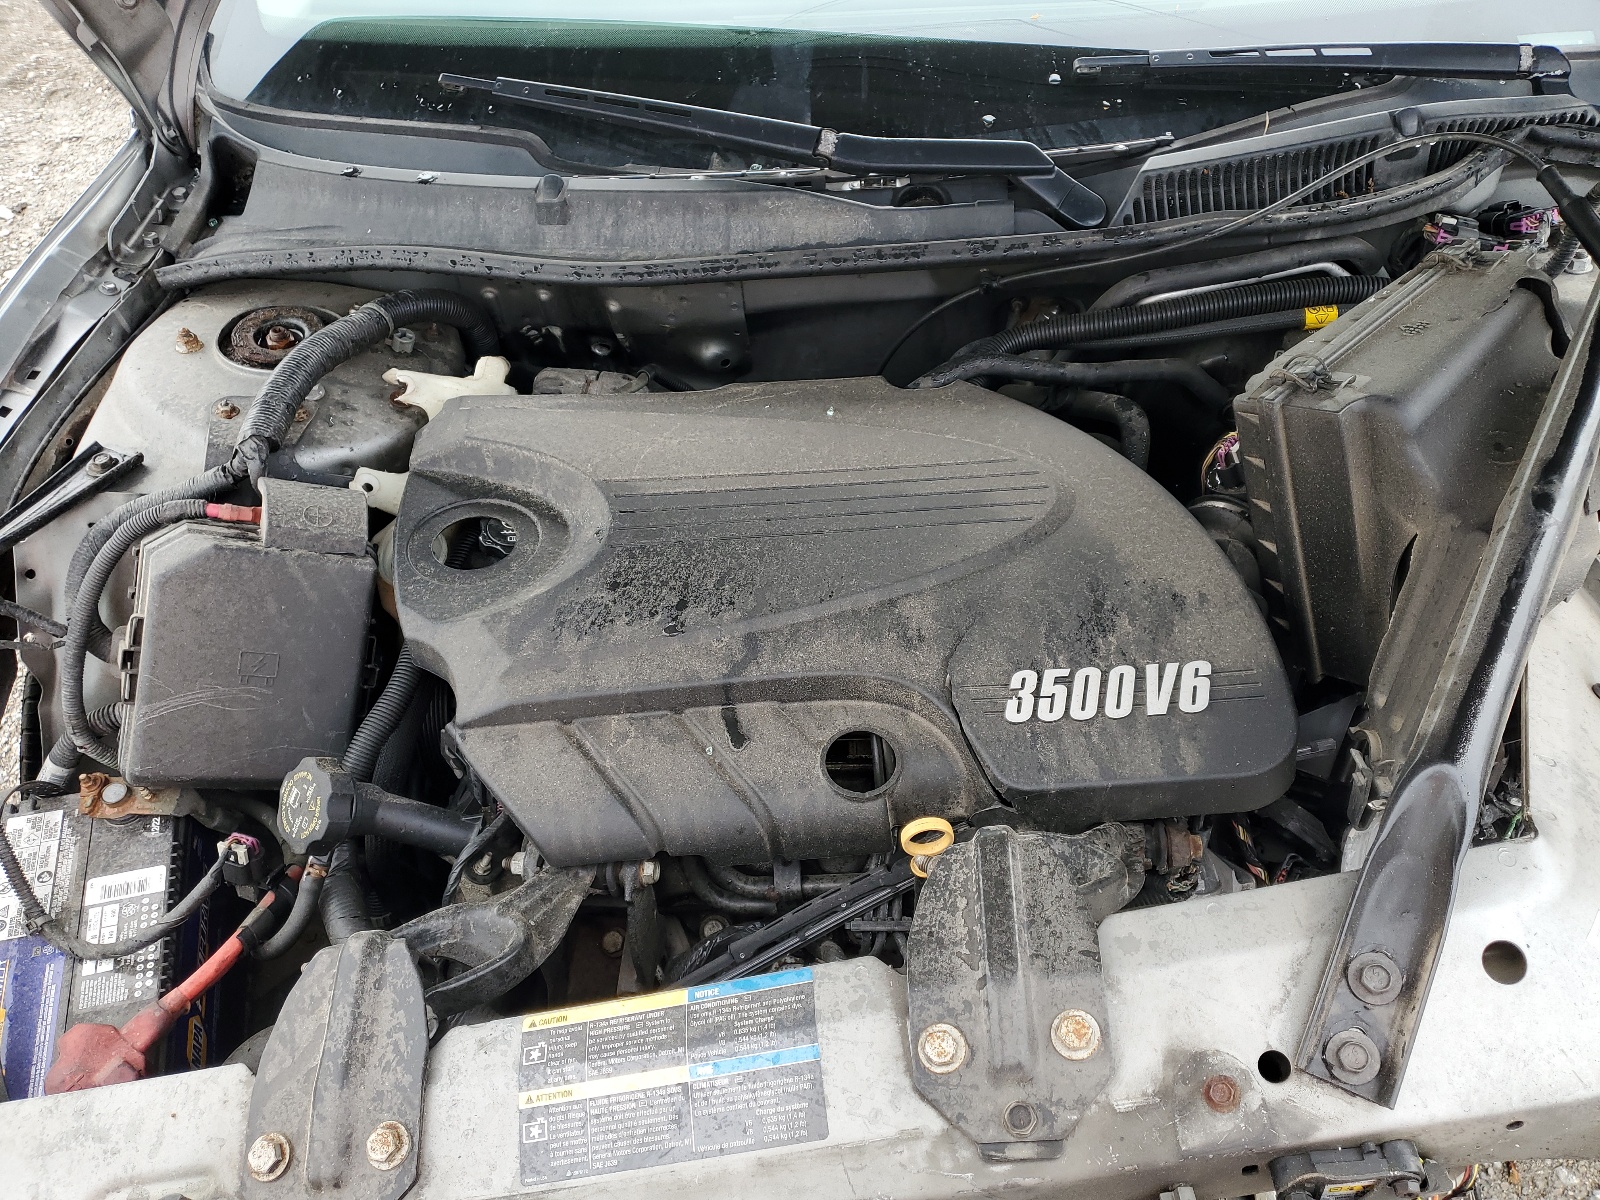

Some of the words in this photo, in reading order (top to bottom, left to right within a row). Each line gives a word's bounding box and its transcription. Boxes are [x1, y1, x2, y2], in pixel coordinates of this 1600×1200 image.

[1005, 669, 1136, 723] 3500
[1145, 660, 1212, 716] V6
[695, 988, 719, 999] NOTICE
[539, 1015, 567, 1025] CAUTION
[734, 1018, 753, 1027] System
[755, 1016, 774, 1024] Charge
[604, 1025, 630, 1033] PRESSURE
[191, 1019, 204, 1069] NAPA
[602, 1041, 624, 1050] Improper
[536, 1090, 572, 1102] ATTENTION
[590, 1098, 608, 1106] FLUIDE
[591, 1107, 608, 1115] HAUTE
[756, 1106, 775, 1115] Charge
[593, 1151, 611, 1160] General
[593, 1161, 603, 1169] SAE
[605, 1159, 617, 1167] J639
